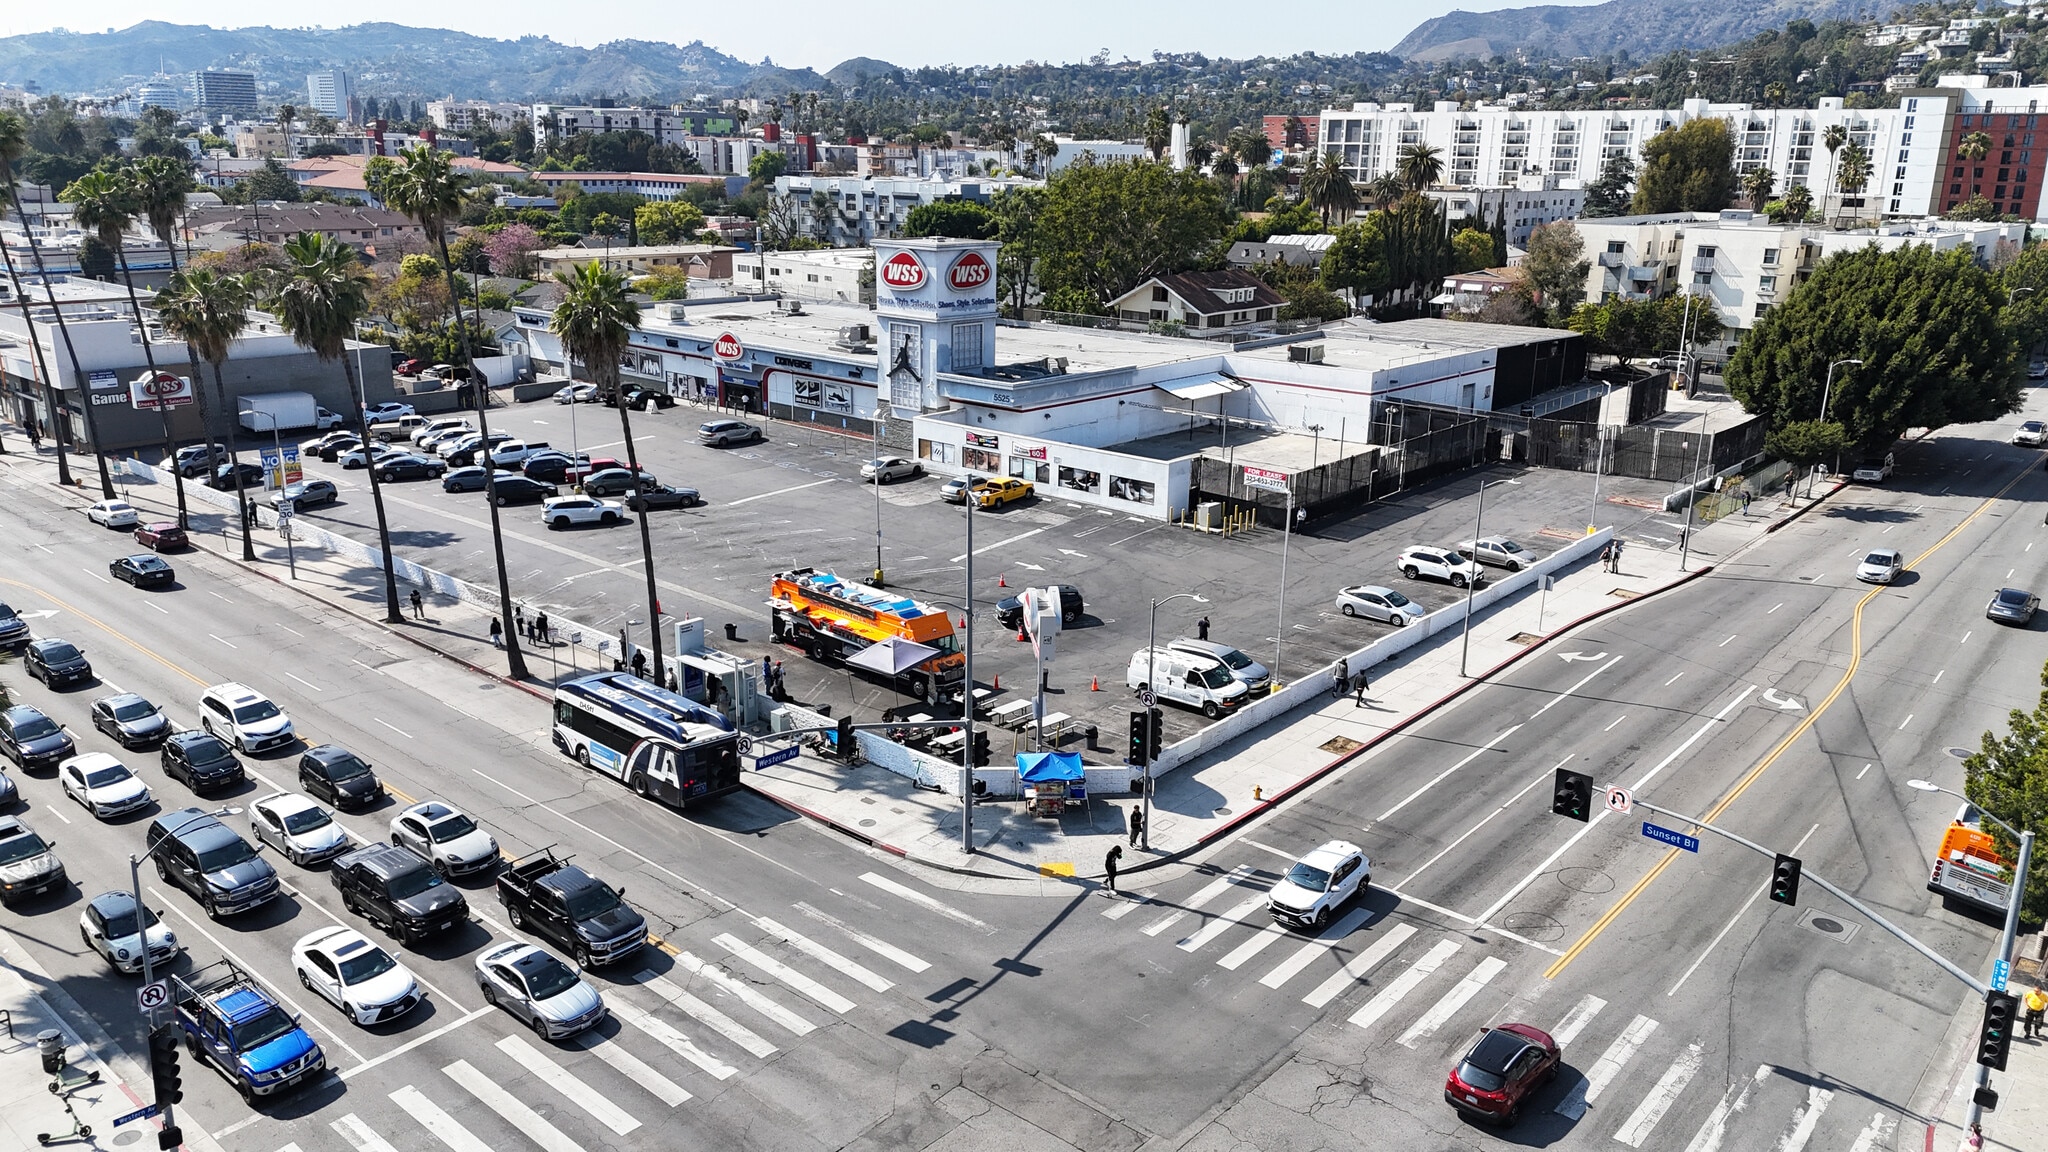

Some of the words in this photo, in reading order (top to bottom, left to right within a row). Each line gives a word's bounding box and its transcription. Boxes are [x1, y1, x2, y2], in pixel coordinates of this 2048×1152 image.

[887, 263, 920, 283] WSS
[954, 264, 987, 283] WSS
[718, 341, 739, 355] WSS
[774, 356, 812, 369] CONVERSE
[993, 393, 1010, 402] 5525
[1247, 468, 1260, 476] FOR
[1263, 471, 1284, 480] LEASE
[579, 701, 595, 713] DASH
[759, 753, 787, 767] Western
[789, 749, 797, 757] Av
[647, 744, 680, 789] LA
[1647, 826, 1680, 844] Sunset
[1684, 838, 1695, 849] Bl
[118, 1109, 146, 1124] Western
